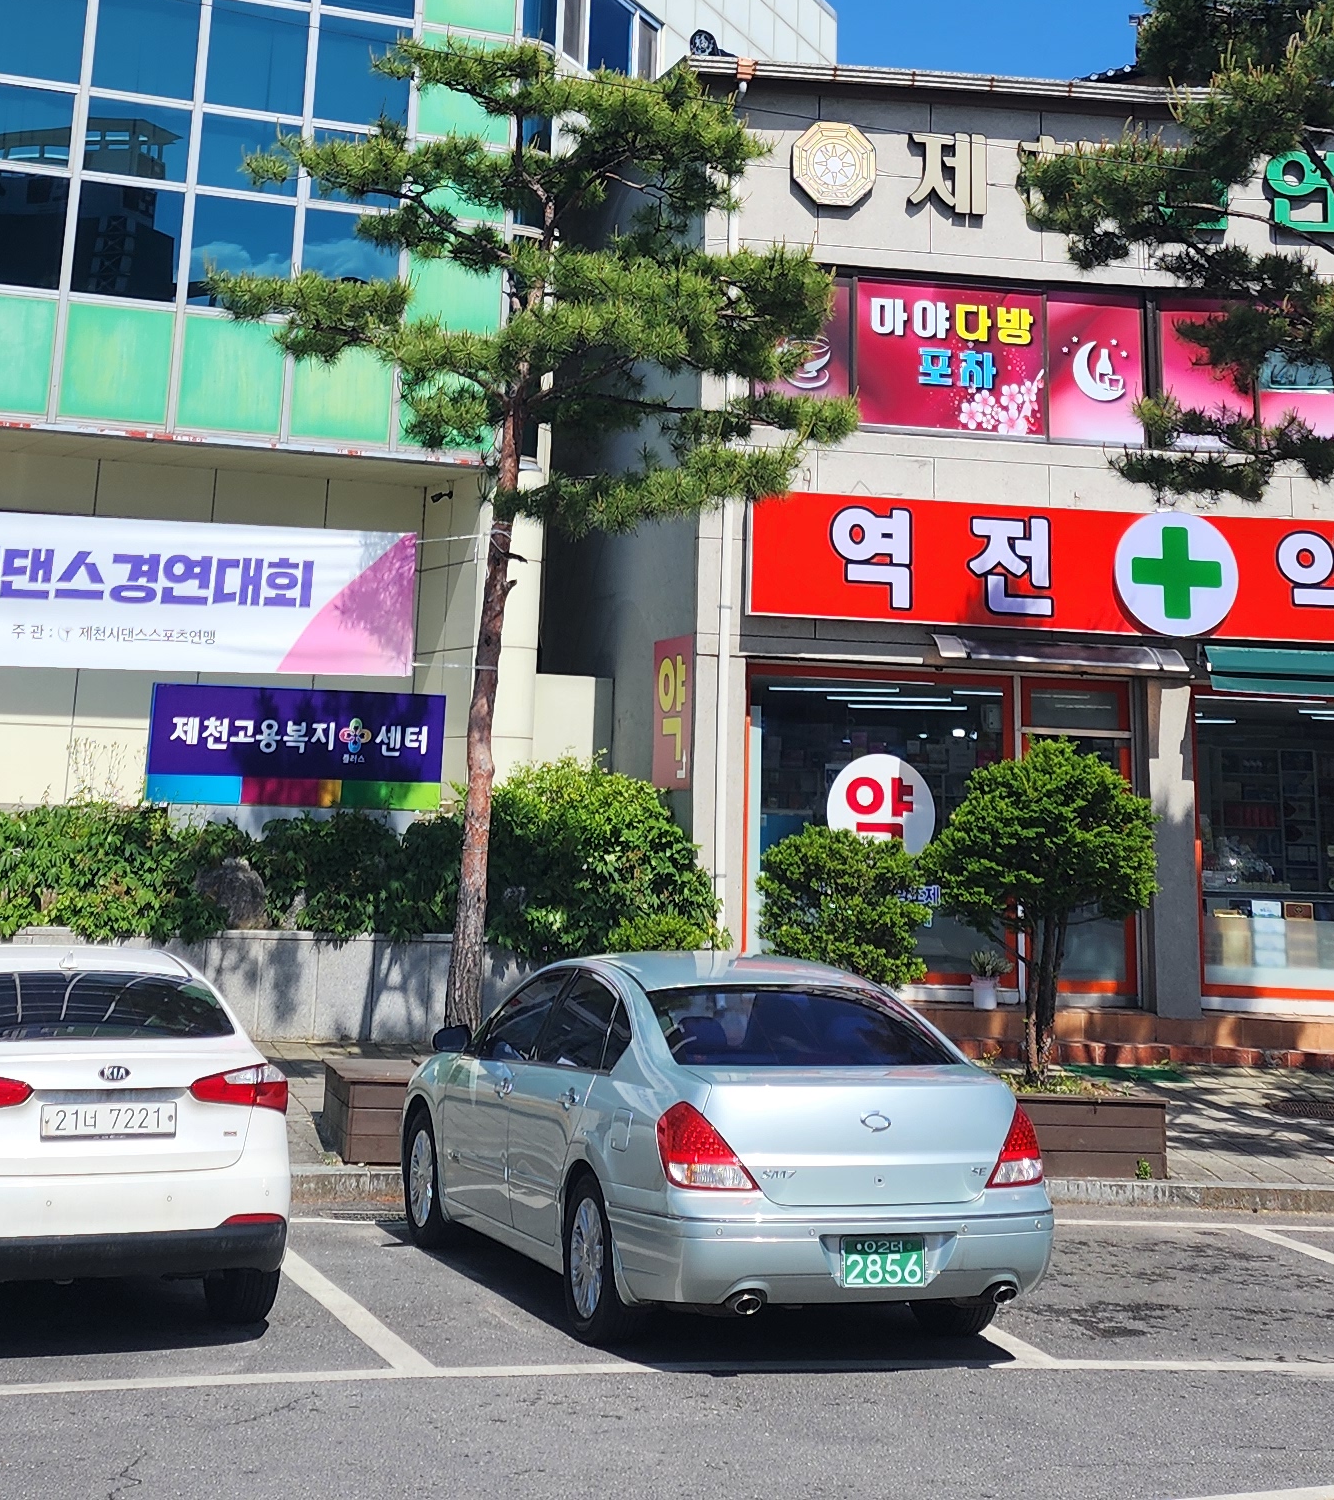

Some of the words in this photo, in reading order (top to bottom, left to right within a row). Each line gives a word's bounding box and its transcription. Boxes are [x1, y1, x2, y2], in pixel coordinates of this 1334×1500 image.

[871, 298, 1034, 345] 마야다방
[918, 347, 997, 389] 포차
[830, 505, 1055, 618] 역전
[78, 625, 217, 645] 제천시댄스스포츠연맹
[658, 653, 687, 761] 약
[169, 715, 336, 754] 제천고용복지
[374, 725, 429, 757] 센터
[341, 753, 365, 764] 플러스
[845, 775, 914, 841] 약
[102, 1067, 127, 1080] KIA
[54, 1108, 98, 1132] 21너
[108, 1106, 162, 1131] 7221
[760, 1169, 798, 1181] SM7
[863, 1240, 905, 1254] 02더
[845, 1253, 923, 1286] 2856
